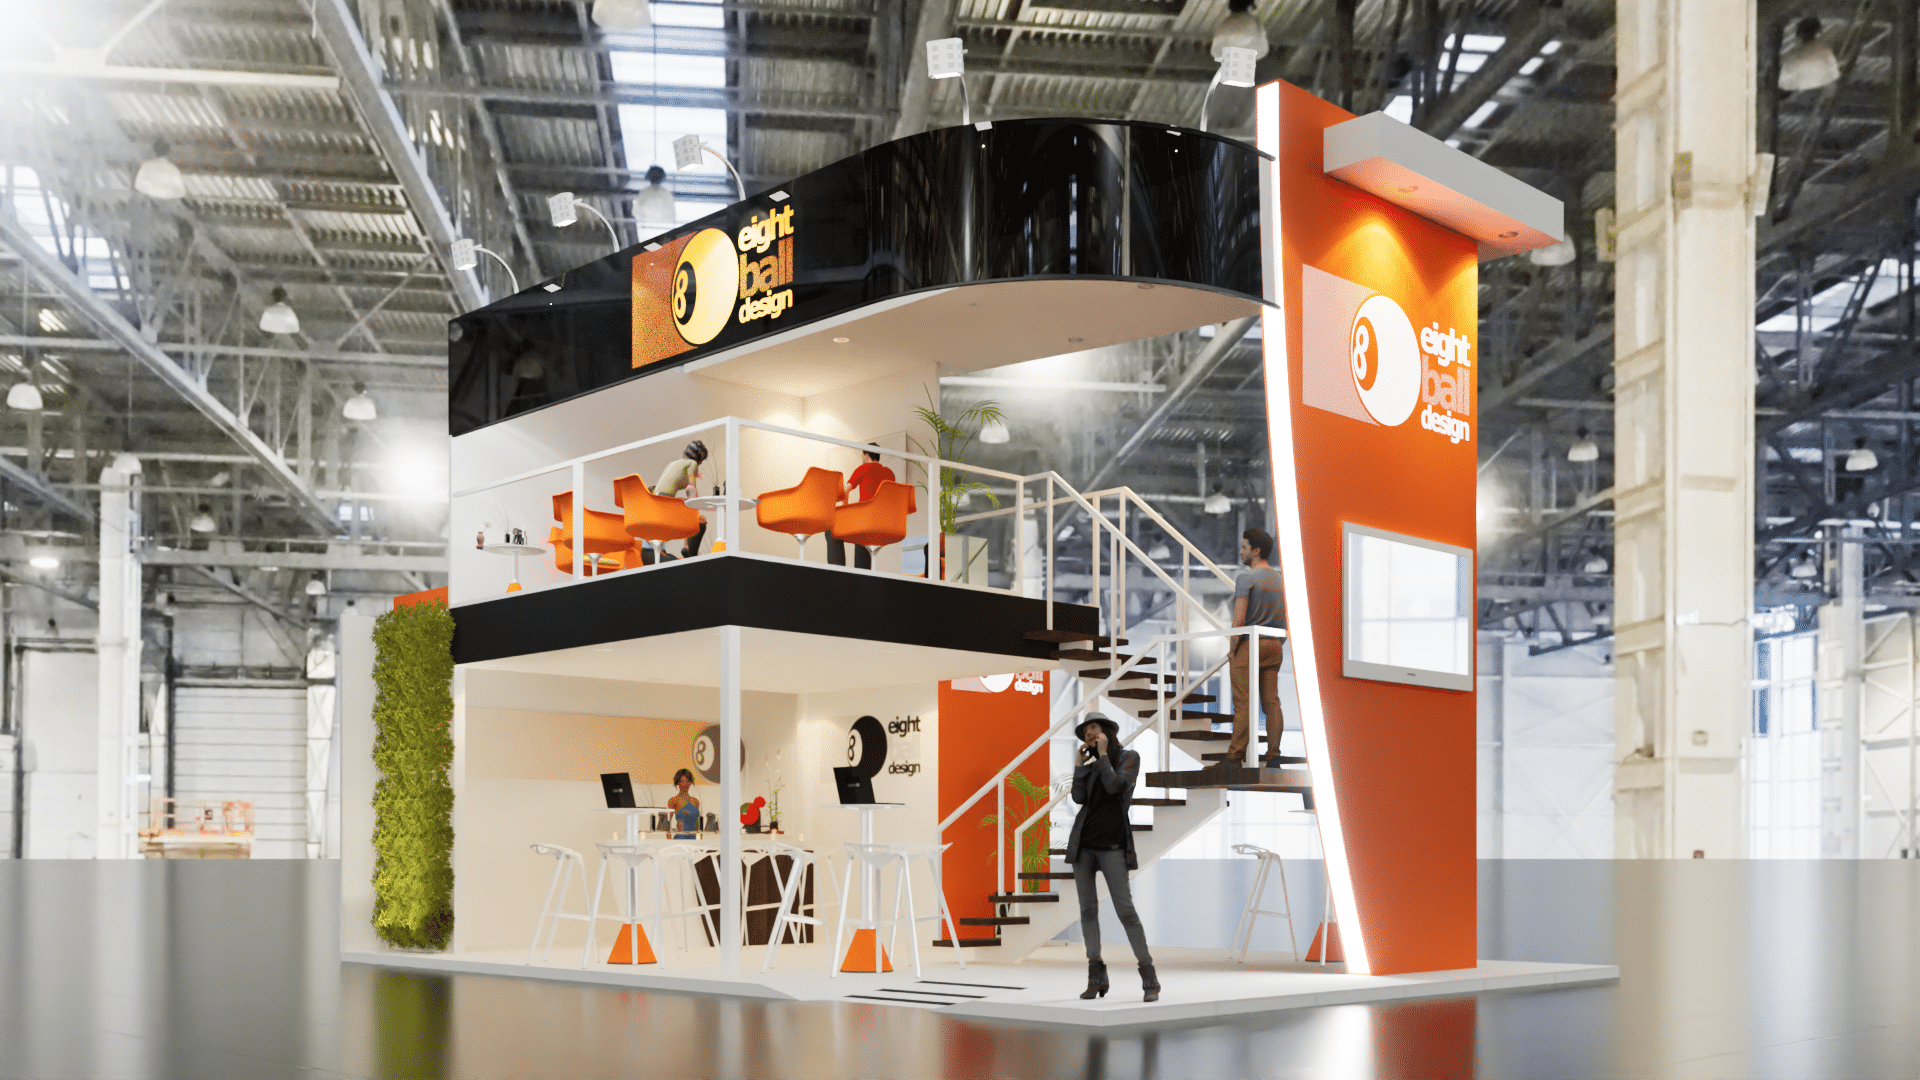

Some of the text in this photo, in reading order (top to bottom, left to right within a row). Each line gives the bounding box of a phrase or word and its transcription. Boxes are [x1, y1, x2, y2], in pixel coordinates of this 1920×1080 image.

[738, 204, 794, 253] eight
[739, 236, 794, 299] ball
[674, 269, 688, 318] 8
[738, 289, 793, 323] design
[1353, 324, 1370, 380] 8
[1420, 321, 1471, 367] eight
[1421, 354, 1471, 416] ball
[1420, 404, 1471, 444] design
[1014, 678, 1044, 695] design
[888, 715, 921, 737] eight
[695, 741, 706, 765] 8
[847, 734, 856, 761] 8
[888, 760, 921, 777] design
